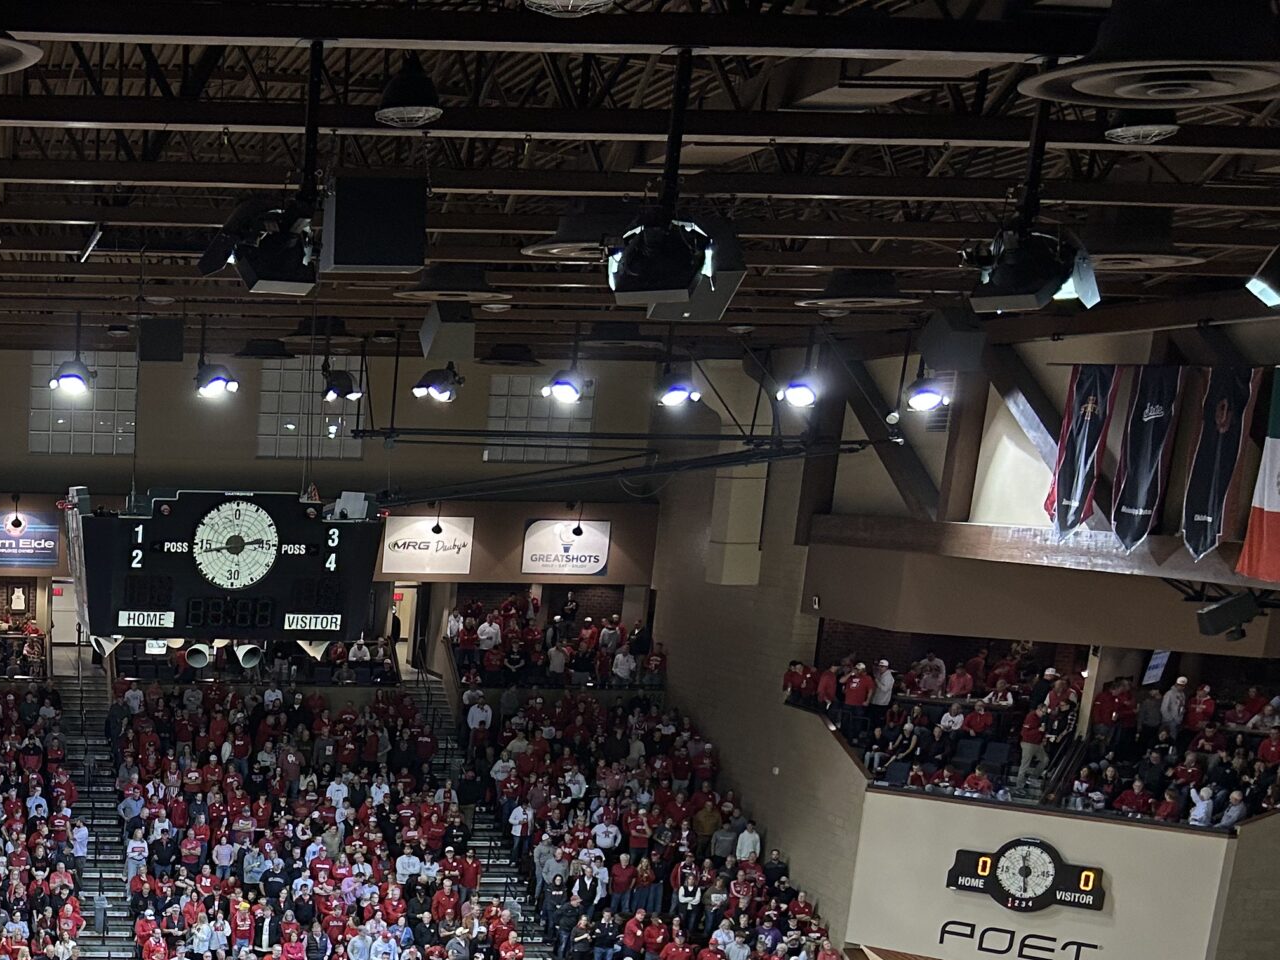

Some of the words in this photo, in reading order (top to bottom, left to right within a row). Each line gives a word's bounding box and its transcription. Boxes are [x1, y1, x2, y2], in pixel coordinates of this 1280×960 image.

[234, 508, 241, 520] 0
[134, 524, 144, 544] 1
[328, 528, 340, 547] 3
[163, 542, 189, 553] POSS
[281, 544, 307, 555] POSS
[394, 541, 431, 551] MRG
[131, 550, 143, 569] 2
[325, 553, 337, 572] 4
[530, 553, 601, 564] GREATSHOTS
[226, 569, 240, 581] 30
[126, 612, 166, 627] HOME
[287, 615, 341, 630] VISITOR
[977, 856, 992, 877] 0
[201, 876, 211, 887] N
[957, 876, 986, 889] HOME
[1079, 870, 1095, 891] 0
[1055, 890, 1094, 905] VISITOR
